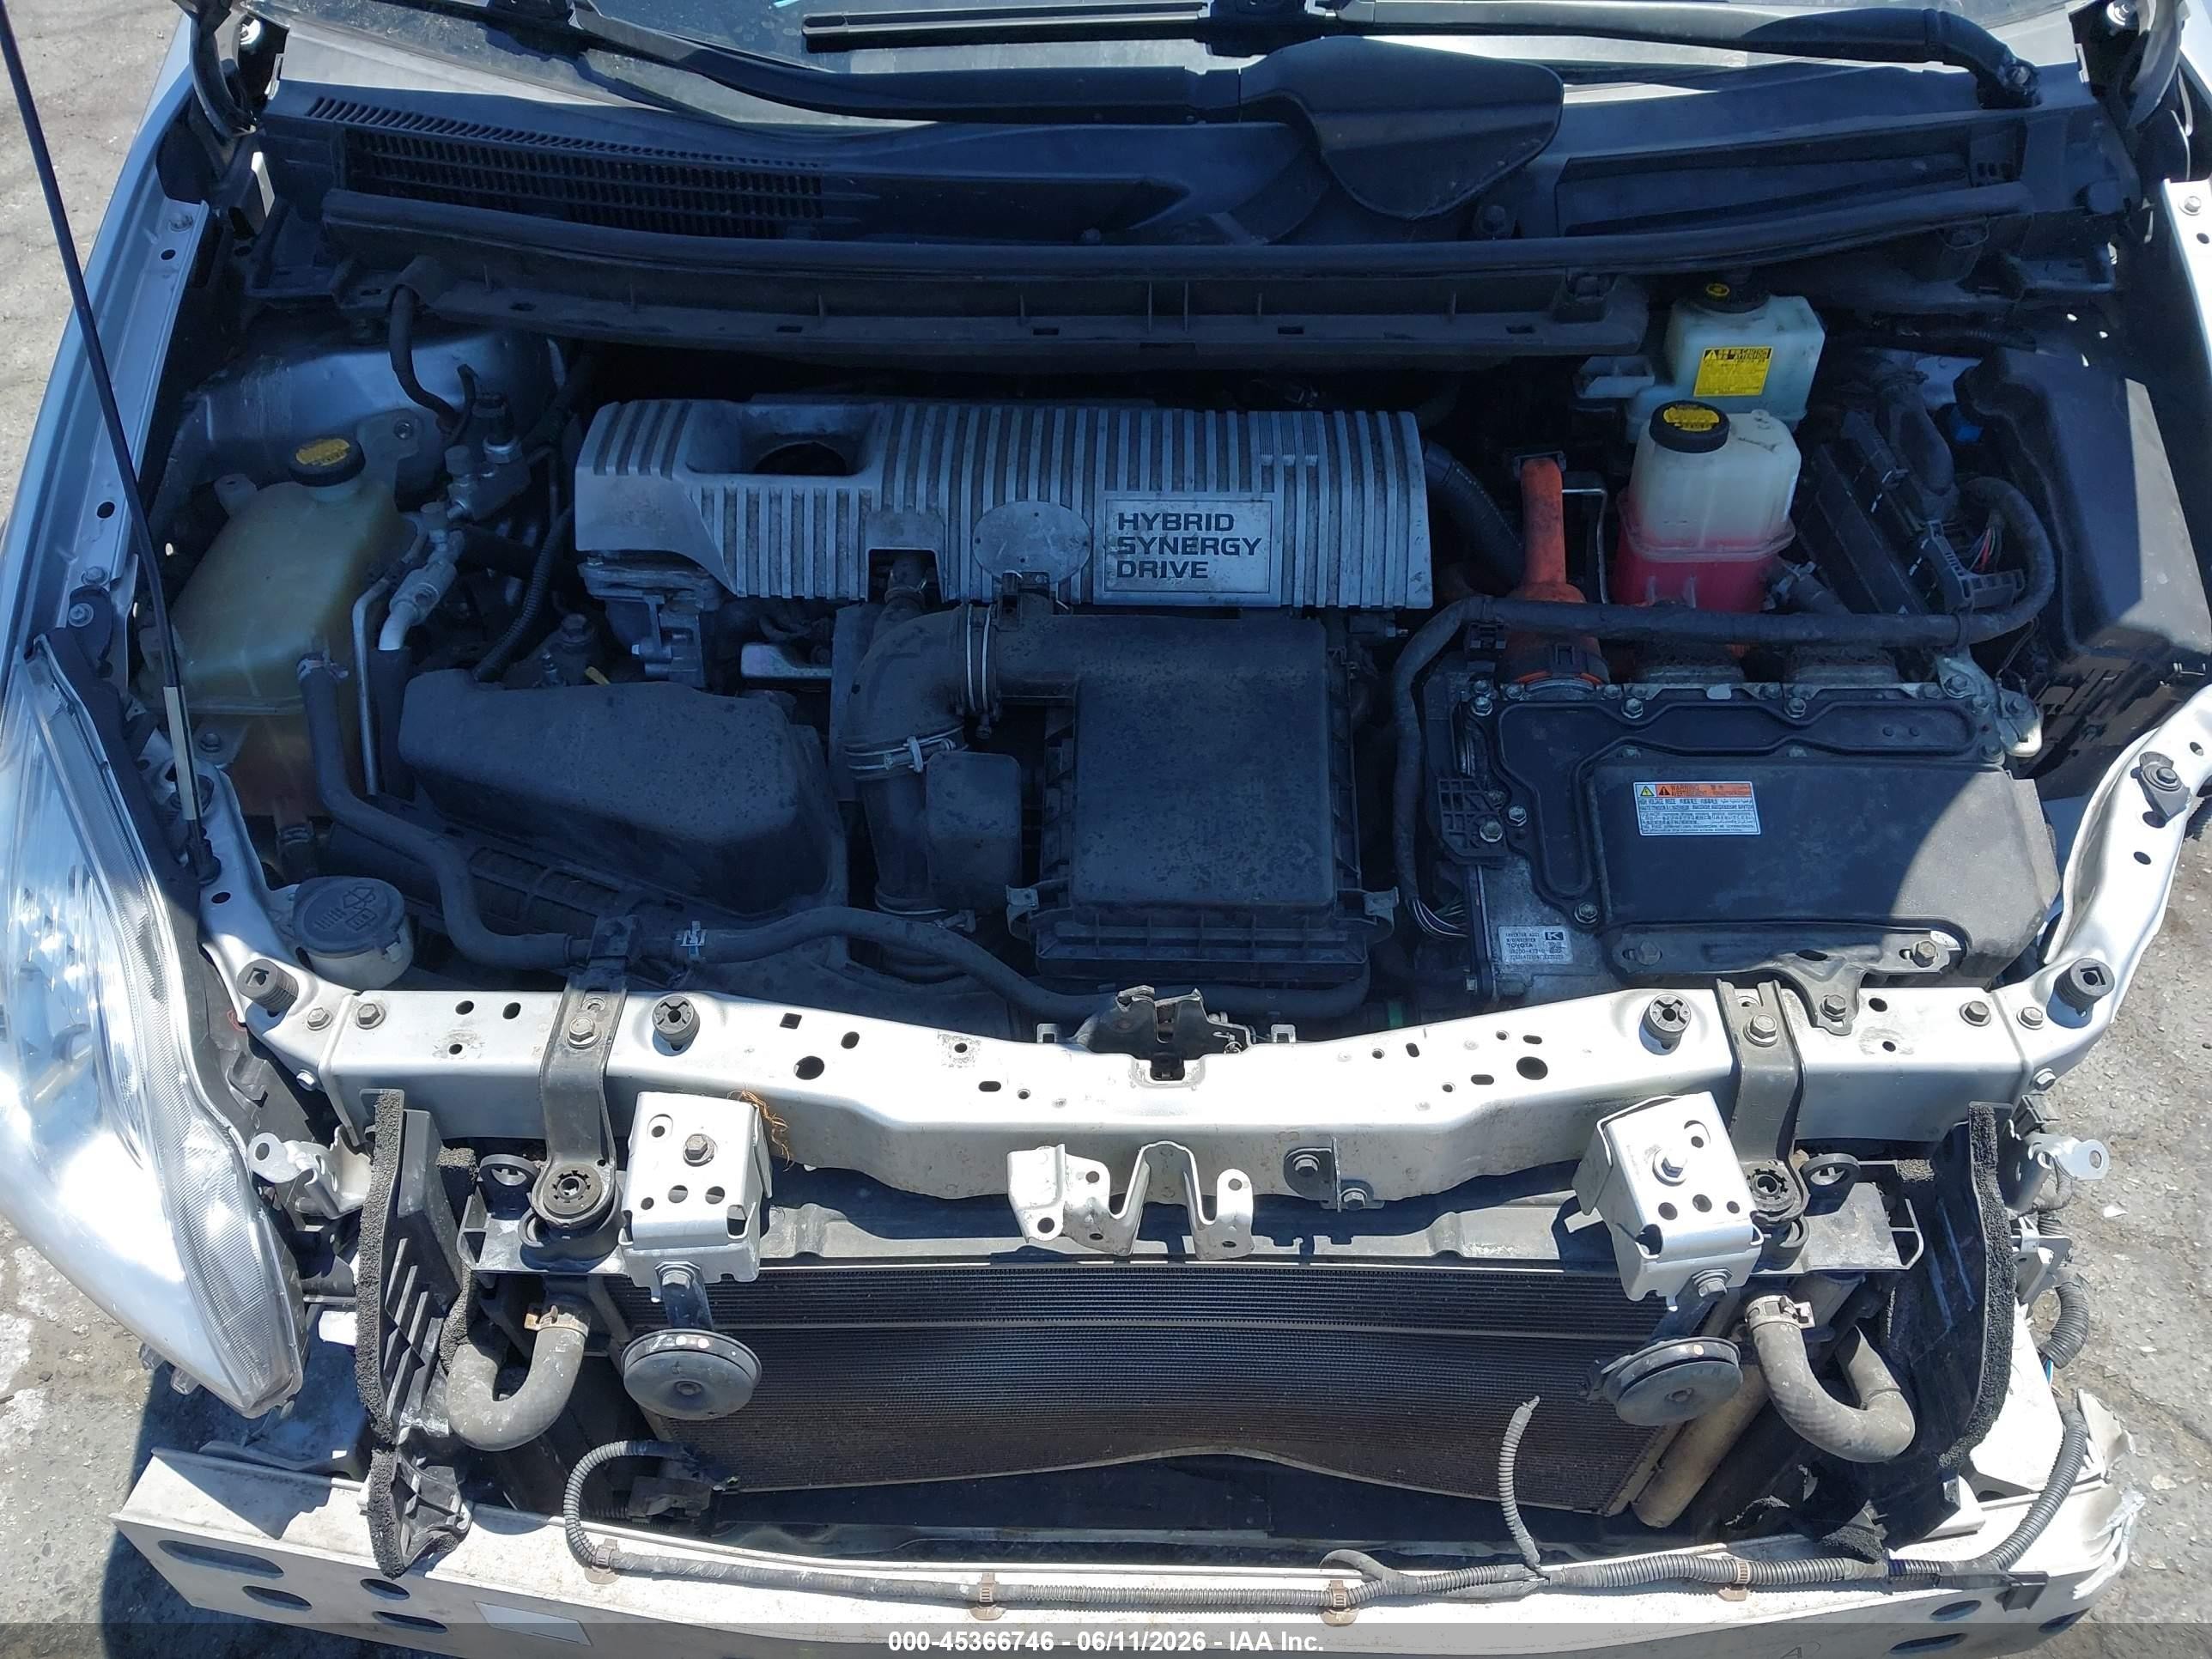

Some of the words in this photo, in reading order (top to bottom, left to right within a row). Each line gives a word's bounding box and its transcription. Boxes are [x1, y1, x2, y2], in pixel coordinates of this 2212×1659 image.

[1117, 512, 1235, 532] HYBRID
[1116, 536, 1262, 556] SYNERGY
[1116, 560, 1209, 579] DRIVE
